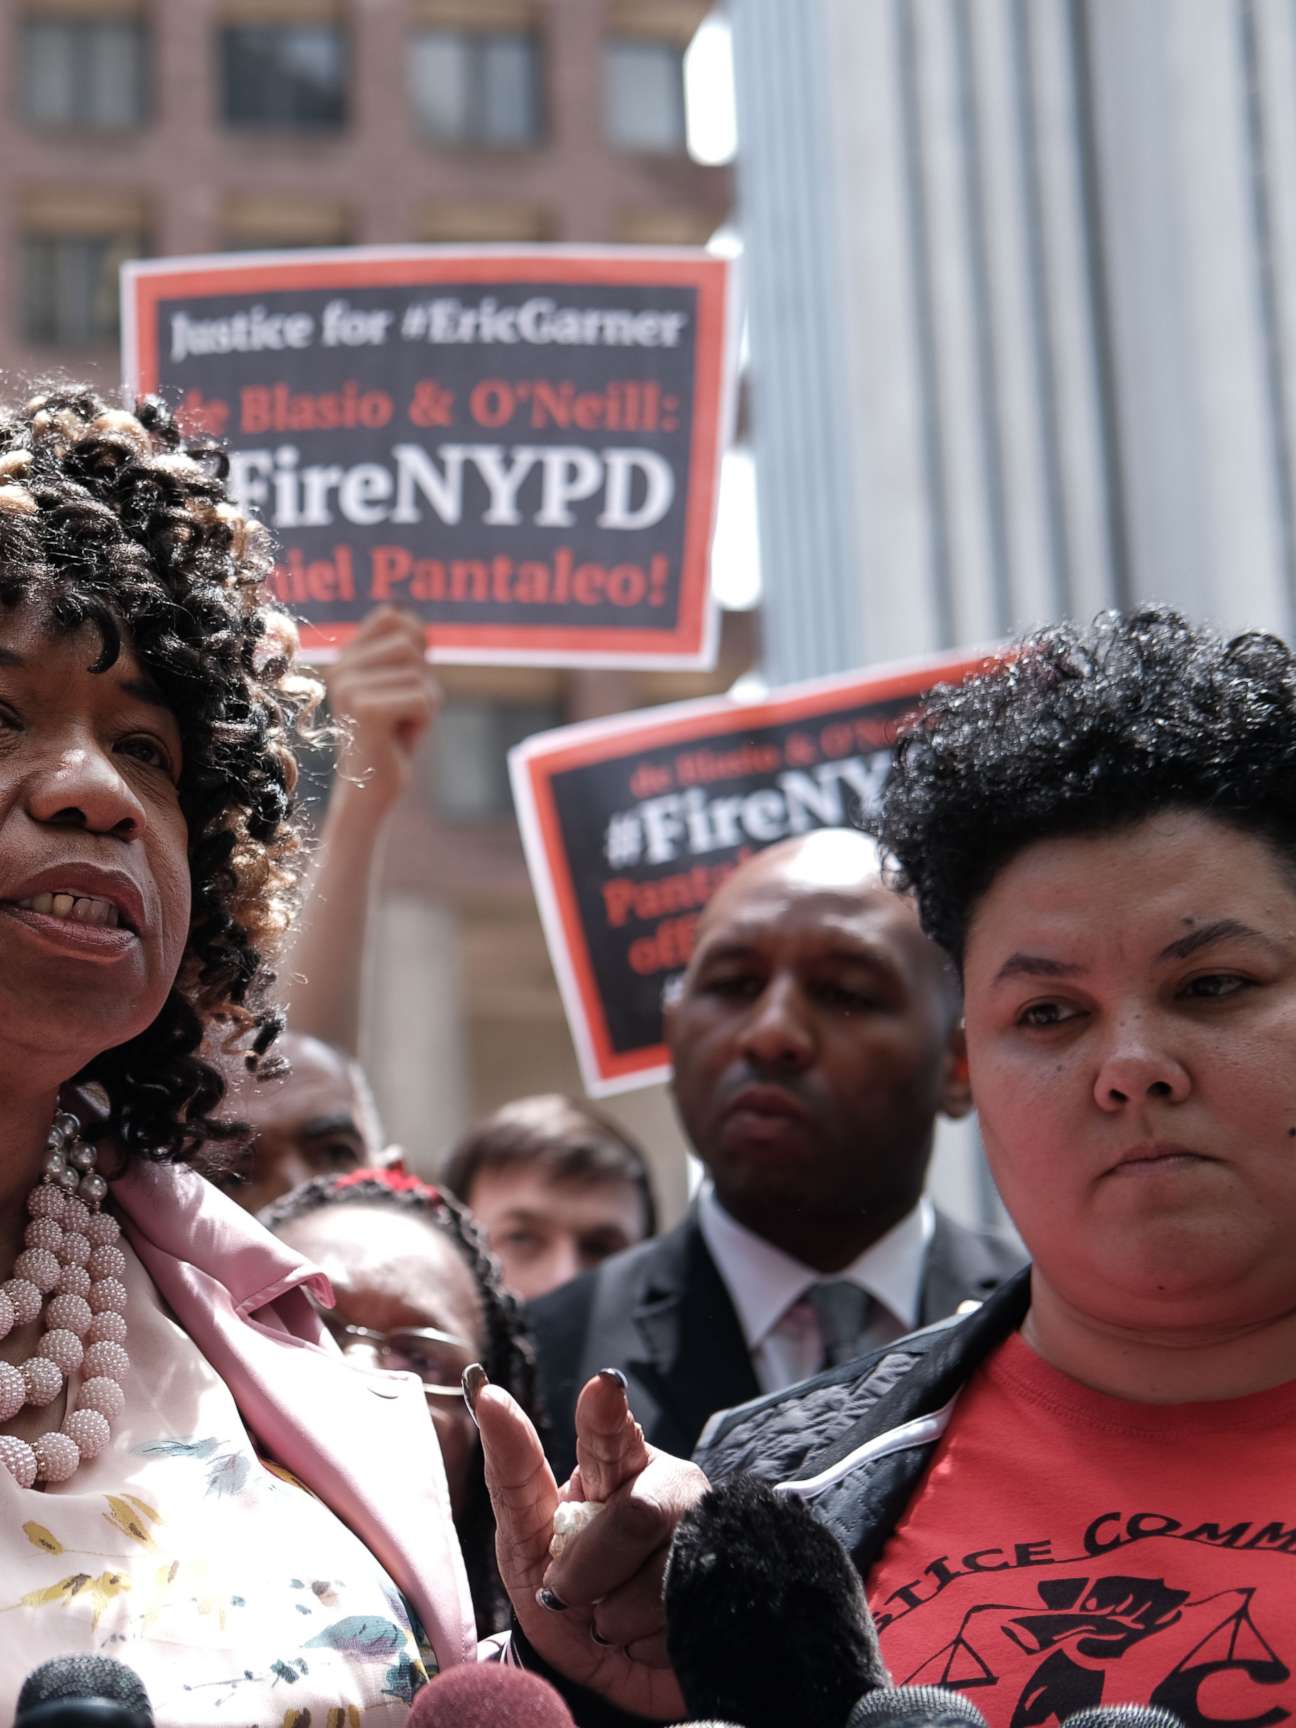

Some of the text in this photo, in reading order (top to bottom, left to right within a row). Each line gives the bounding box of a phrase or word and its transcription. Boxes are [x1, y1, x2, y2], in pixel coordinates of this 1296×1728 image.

[170, 296, 687, 362] Justice for #EricGarner
[239, 381, 393, 435] Blasio
[408, 379, 453, 429] &
[469, 377, 680, 431] O'Neill:
[208, 441, 675, 530] FireNYPD
[370, 545, 669, 608] Pantaleo!
[606, 750, 896, 870] #FireNY
